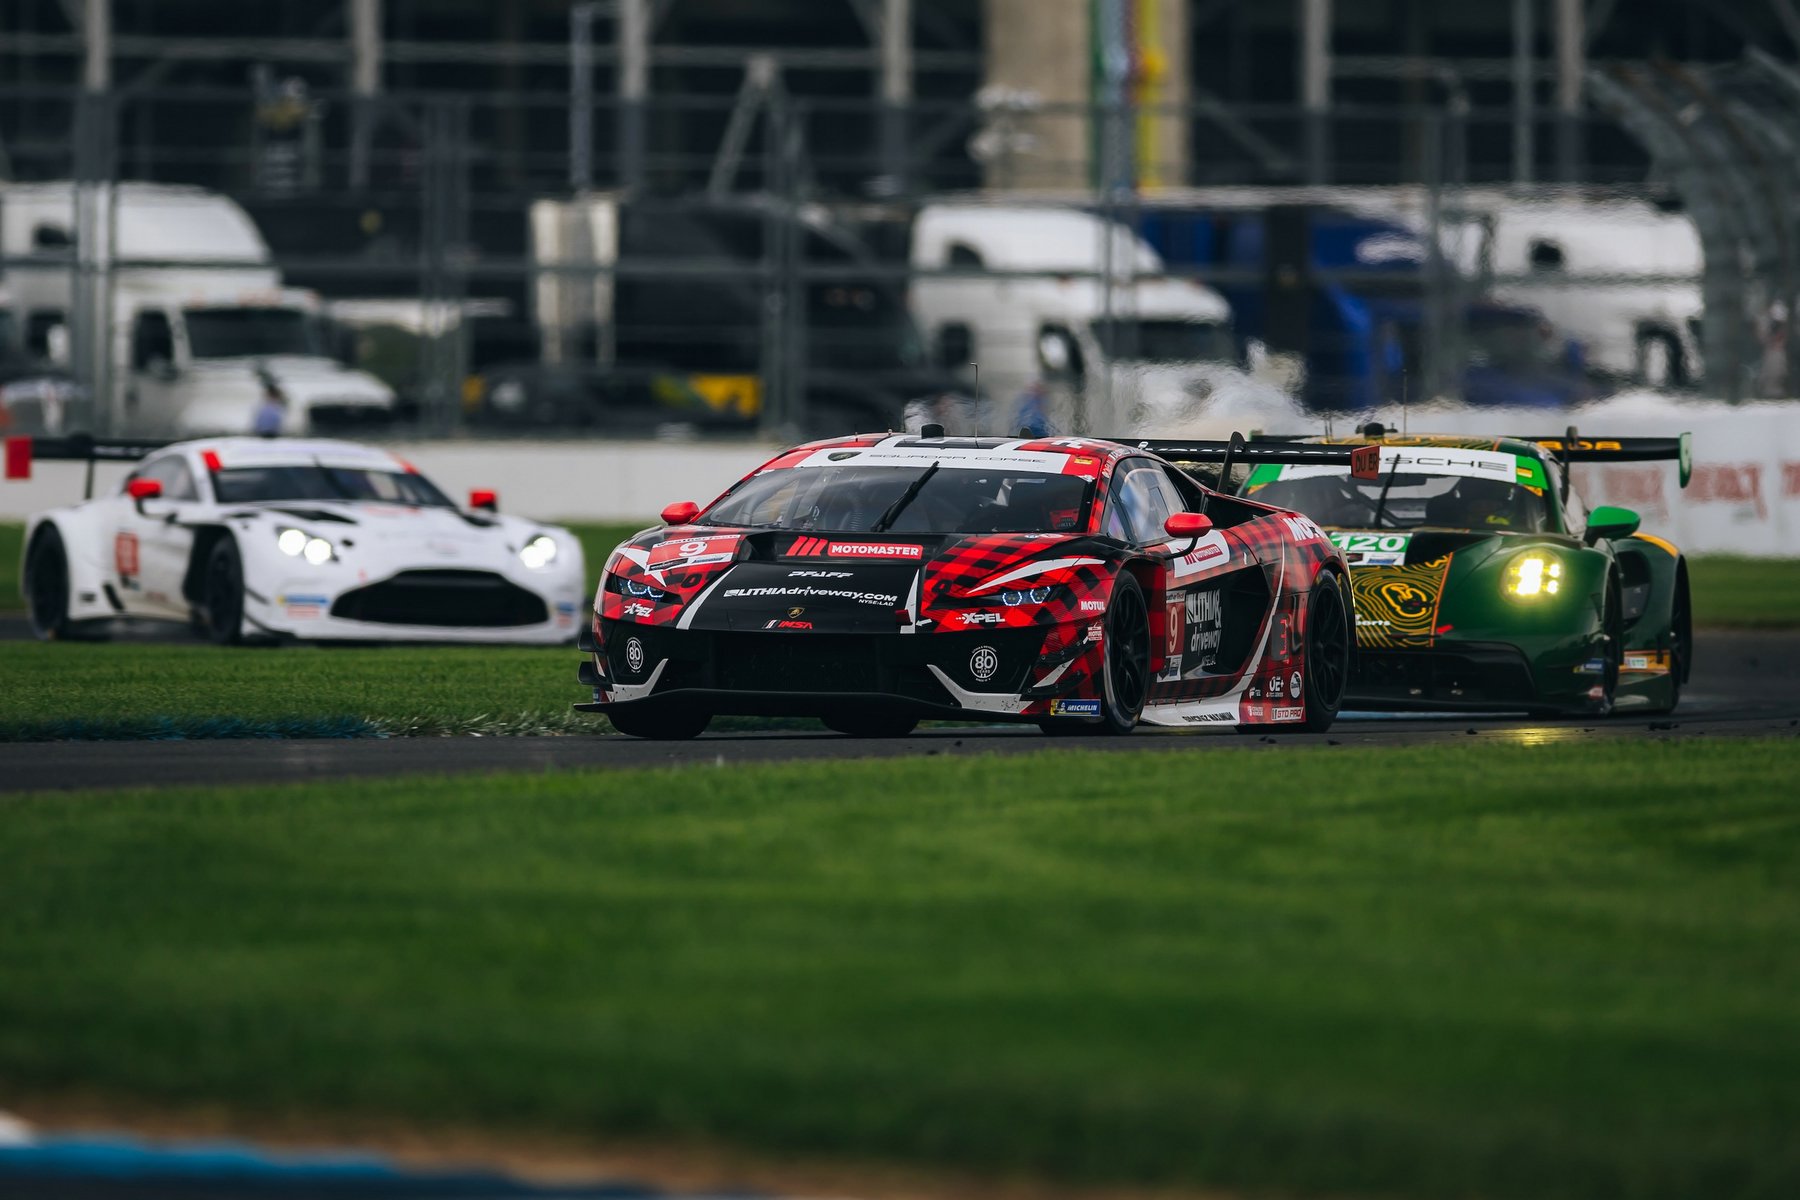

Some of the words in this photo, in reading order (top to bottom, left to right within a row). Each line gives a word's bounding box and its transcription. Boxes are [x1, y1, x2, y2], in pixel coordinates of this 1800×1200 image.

[869, 453, 967, 461] SQUADRA
[974, 456, 1047, 464] CORSE
[678, 541, 707, 557] 9
[1331, 535, 1406, 551] 120
[831, 544, 919, 556] MOTOMASTER
[788, 570, 853, 578] PFAFF
[1081, 601, 1106, 611] MOTUL
[963, 612, 1005, 624] XPEL
[778, 621, 813, 629] IMSA
[1169, 606, 1178, 653] 9
[1190, 624, 1222, 655] driveway
[629, 647, 641, 660] 80
[975, 655, 994, 669] 80
